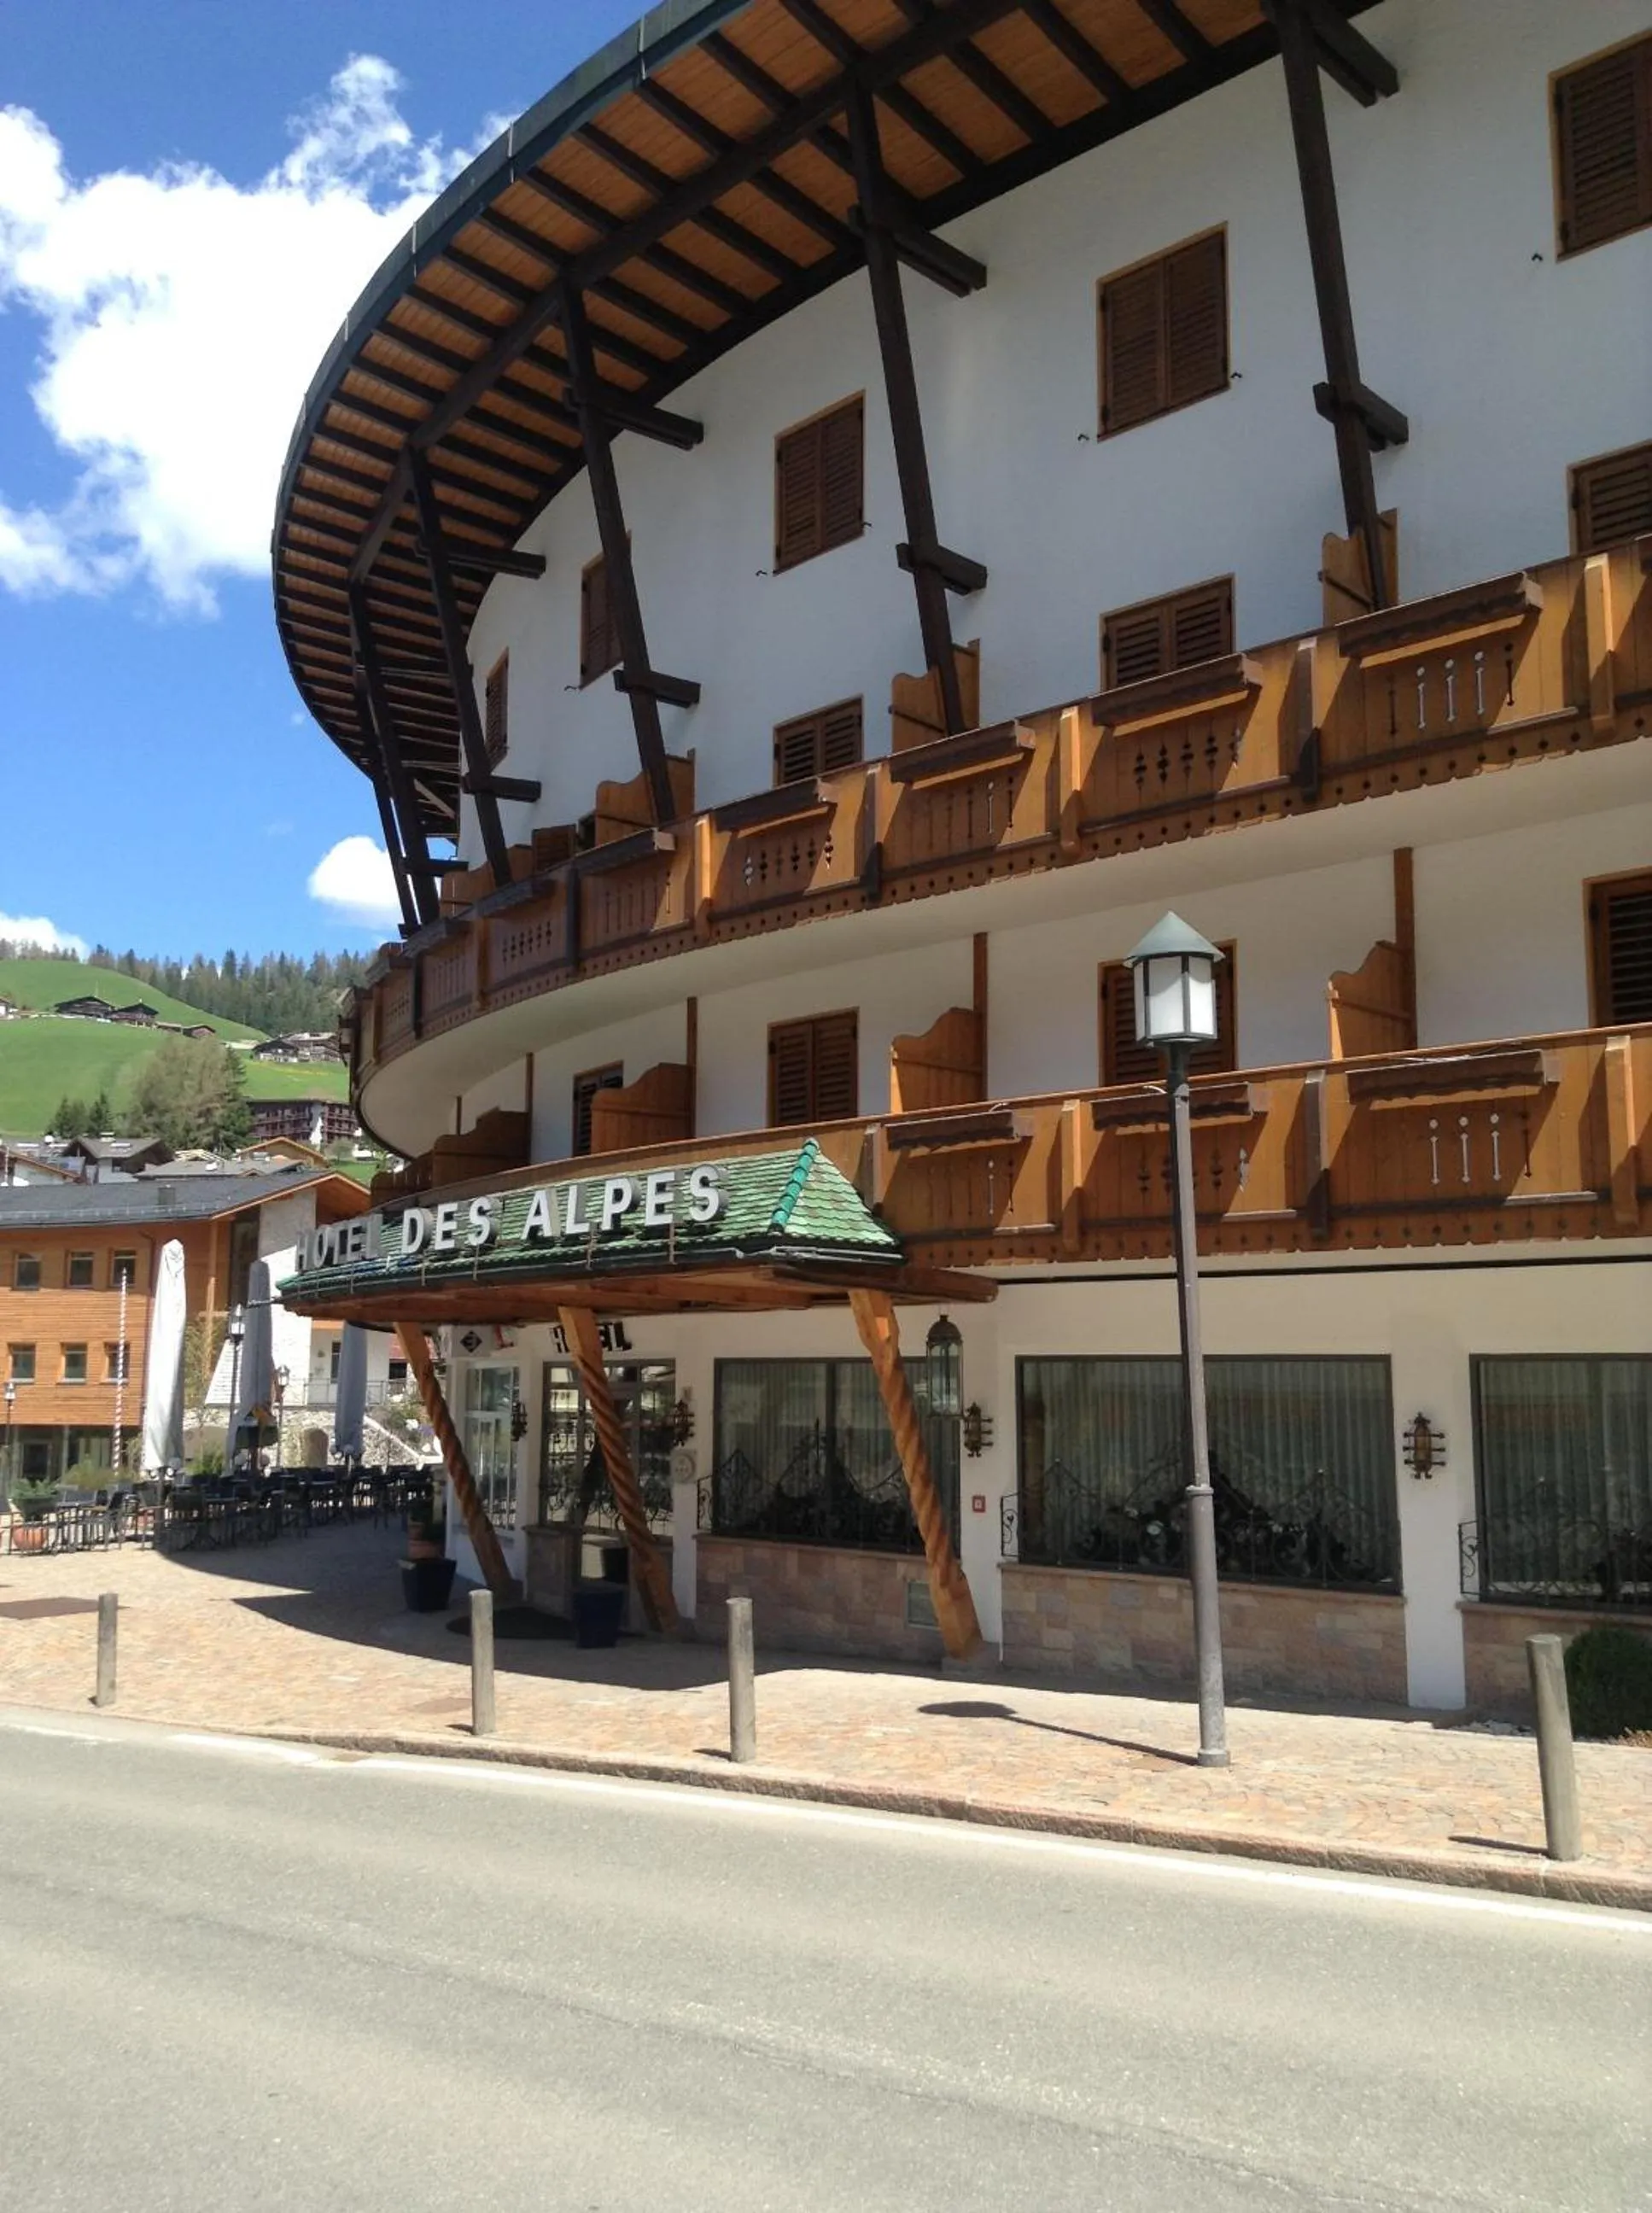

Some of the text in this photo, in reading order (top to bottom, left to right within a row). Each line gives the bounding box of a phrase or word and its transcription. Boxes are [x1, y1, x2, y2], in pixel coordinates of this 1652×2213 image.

[295, 1164, 727, 1272] HOTEL DES ALPES
